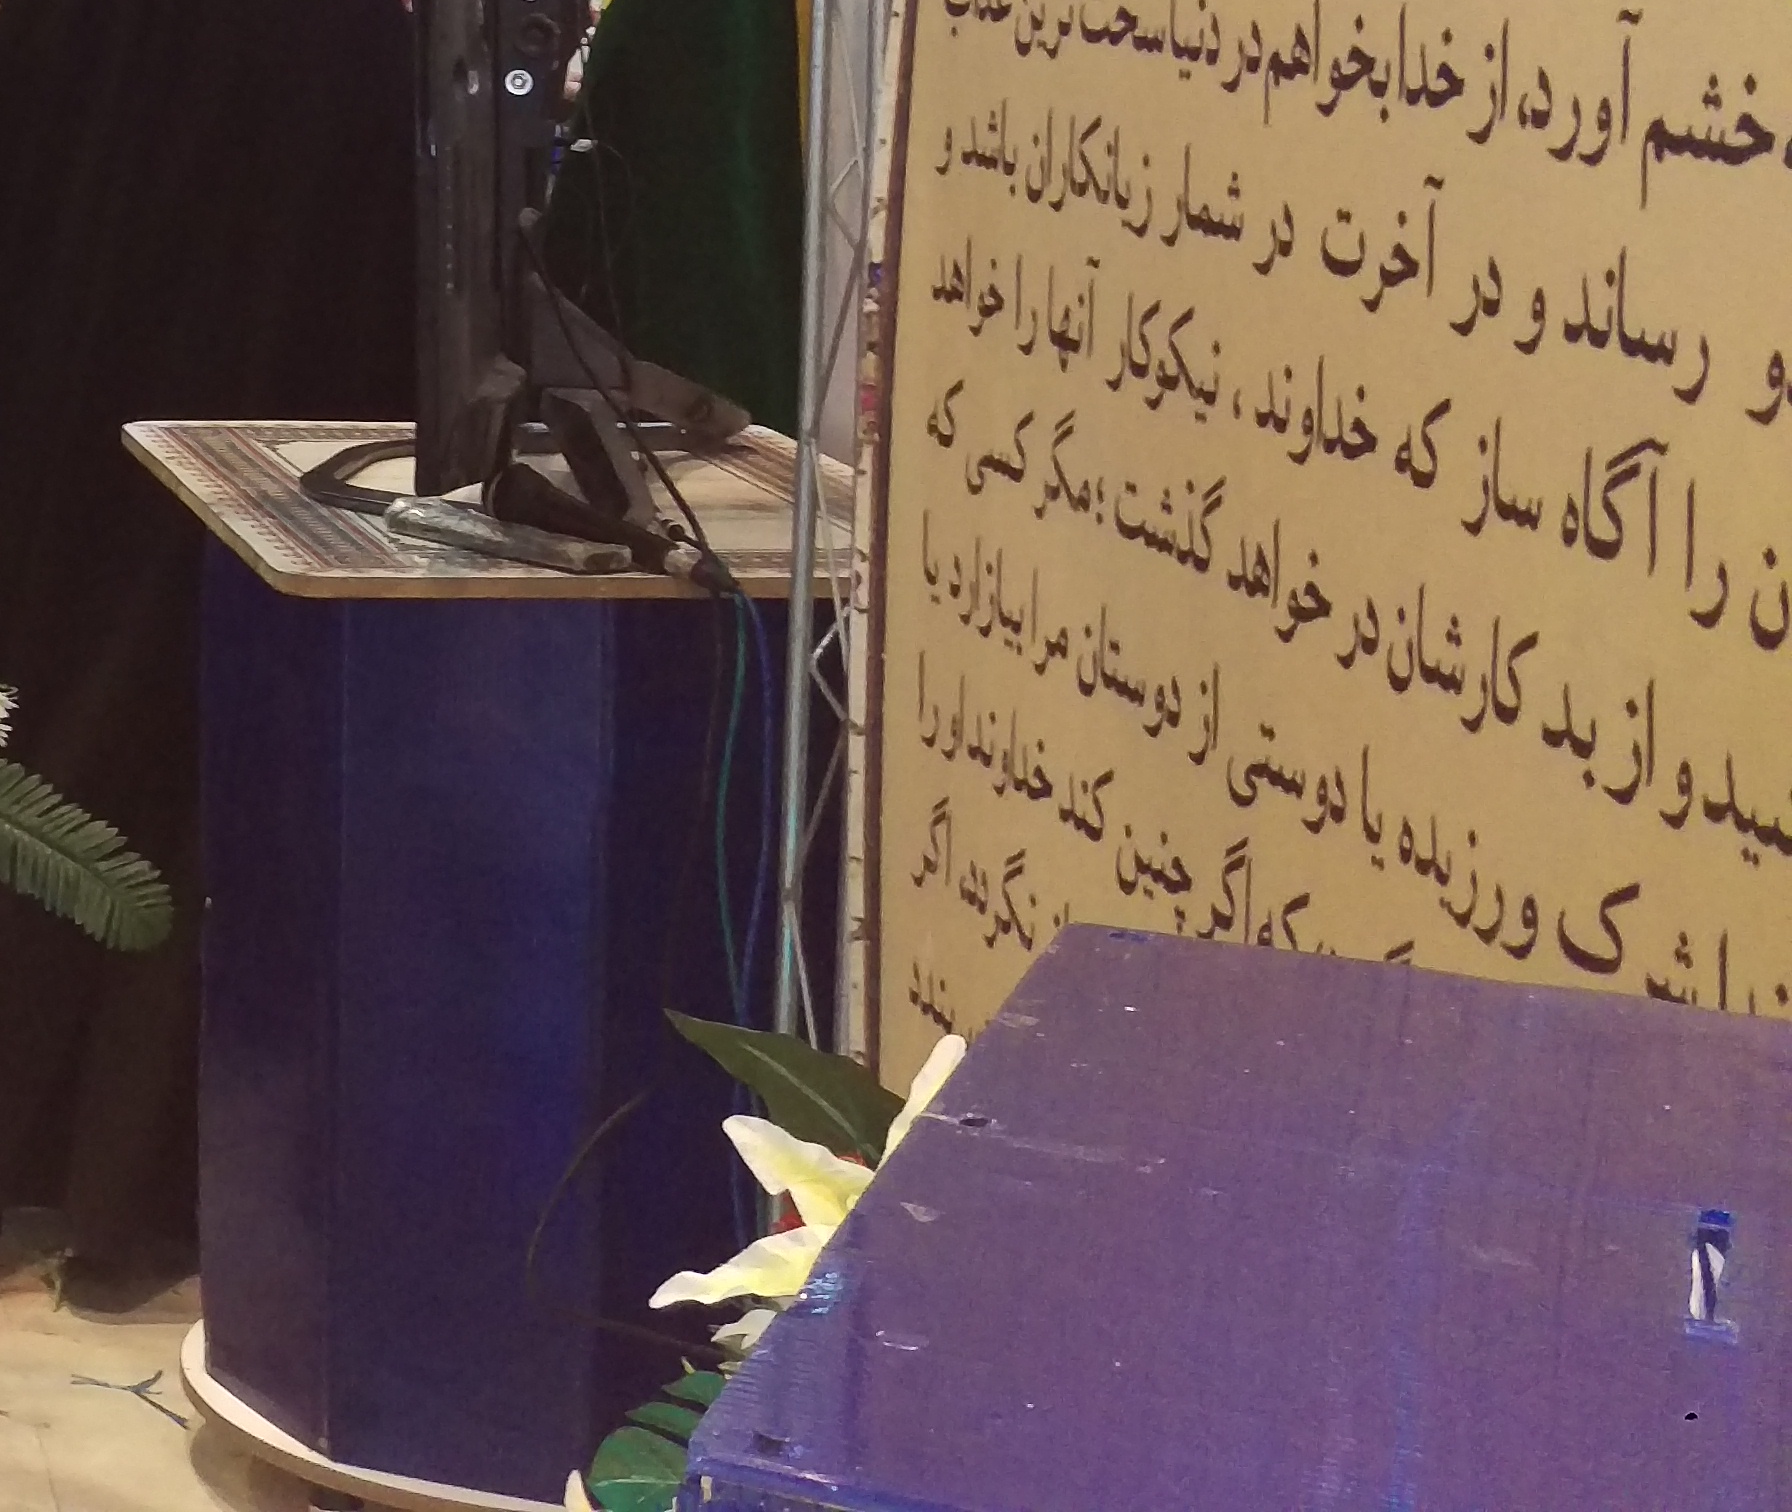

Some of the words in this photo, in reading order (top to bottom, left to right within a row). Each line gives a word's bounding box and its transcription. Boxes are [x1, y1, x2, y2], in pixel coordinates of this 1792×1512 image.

[1220, 20, 1263, 93] در
[1398, 2, 1466, 108] خدا
[1466, 18, 1509, 146] از
[935, 127, 952, 176] و
[961, 99, 1017, 197] باشد
[1025, 108, 1153, 239] زیانکاران
[1639, 72, 1777, 210] خشم
[1160, 143, 1244, 247] شمار
[1252, 201, 1294, 277] در
[1320, 174, 1445, 314] آخرت
[931, 237, 1005, 337] خواهد
[1015, 254, 1038, 356] را
[1047, 256, 1100, 373] آنها
[1449, 256, 1503, 337] در
[1513, 287, 1546, 356] و
[1562, 246, 1710, 406] رساند
[1105, 293, 1222, 424] نیکوکار
[927, 379, 965, 448] که
[965, 410, 1035, 495] کسی
[1032, 409, 1091, 520] مگر
[1393, 397, 1452, 490] که
[1461, 416, 1543, 537] ساز
[1560, 437, 1670, 577] آگاه
[922, 510, 941, 605] یا
[1226, 518, 1333, 643] خواهد
[1685, 478, 1729, 630] را
[1031, 568, 1069, 676] مرا
[1076, 606, 1182, 739] دوستان
[1334, 597, 1380, 670] در
[919, 650, 940, 748] را
[941, 674, 964, 762] او
[1187, 662, 1220, 766] از
[1540, 682, 1597, 790] بد
[1601, 677, 1656, 806] از
[1058, 768, 1115, 842] کند
[1226, 722, 1348, 834] دوستی
[1361, 744, 1385, 871] یا
[1658, 758, 1694, 830] و
[1398, 815, 1539, 960] ورزیده
